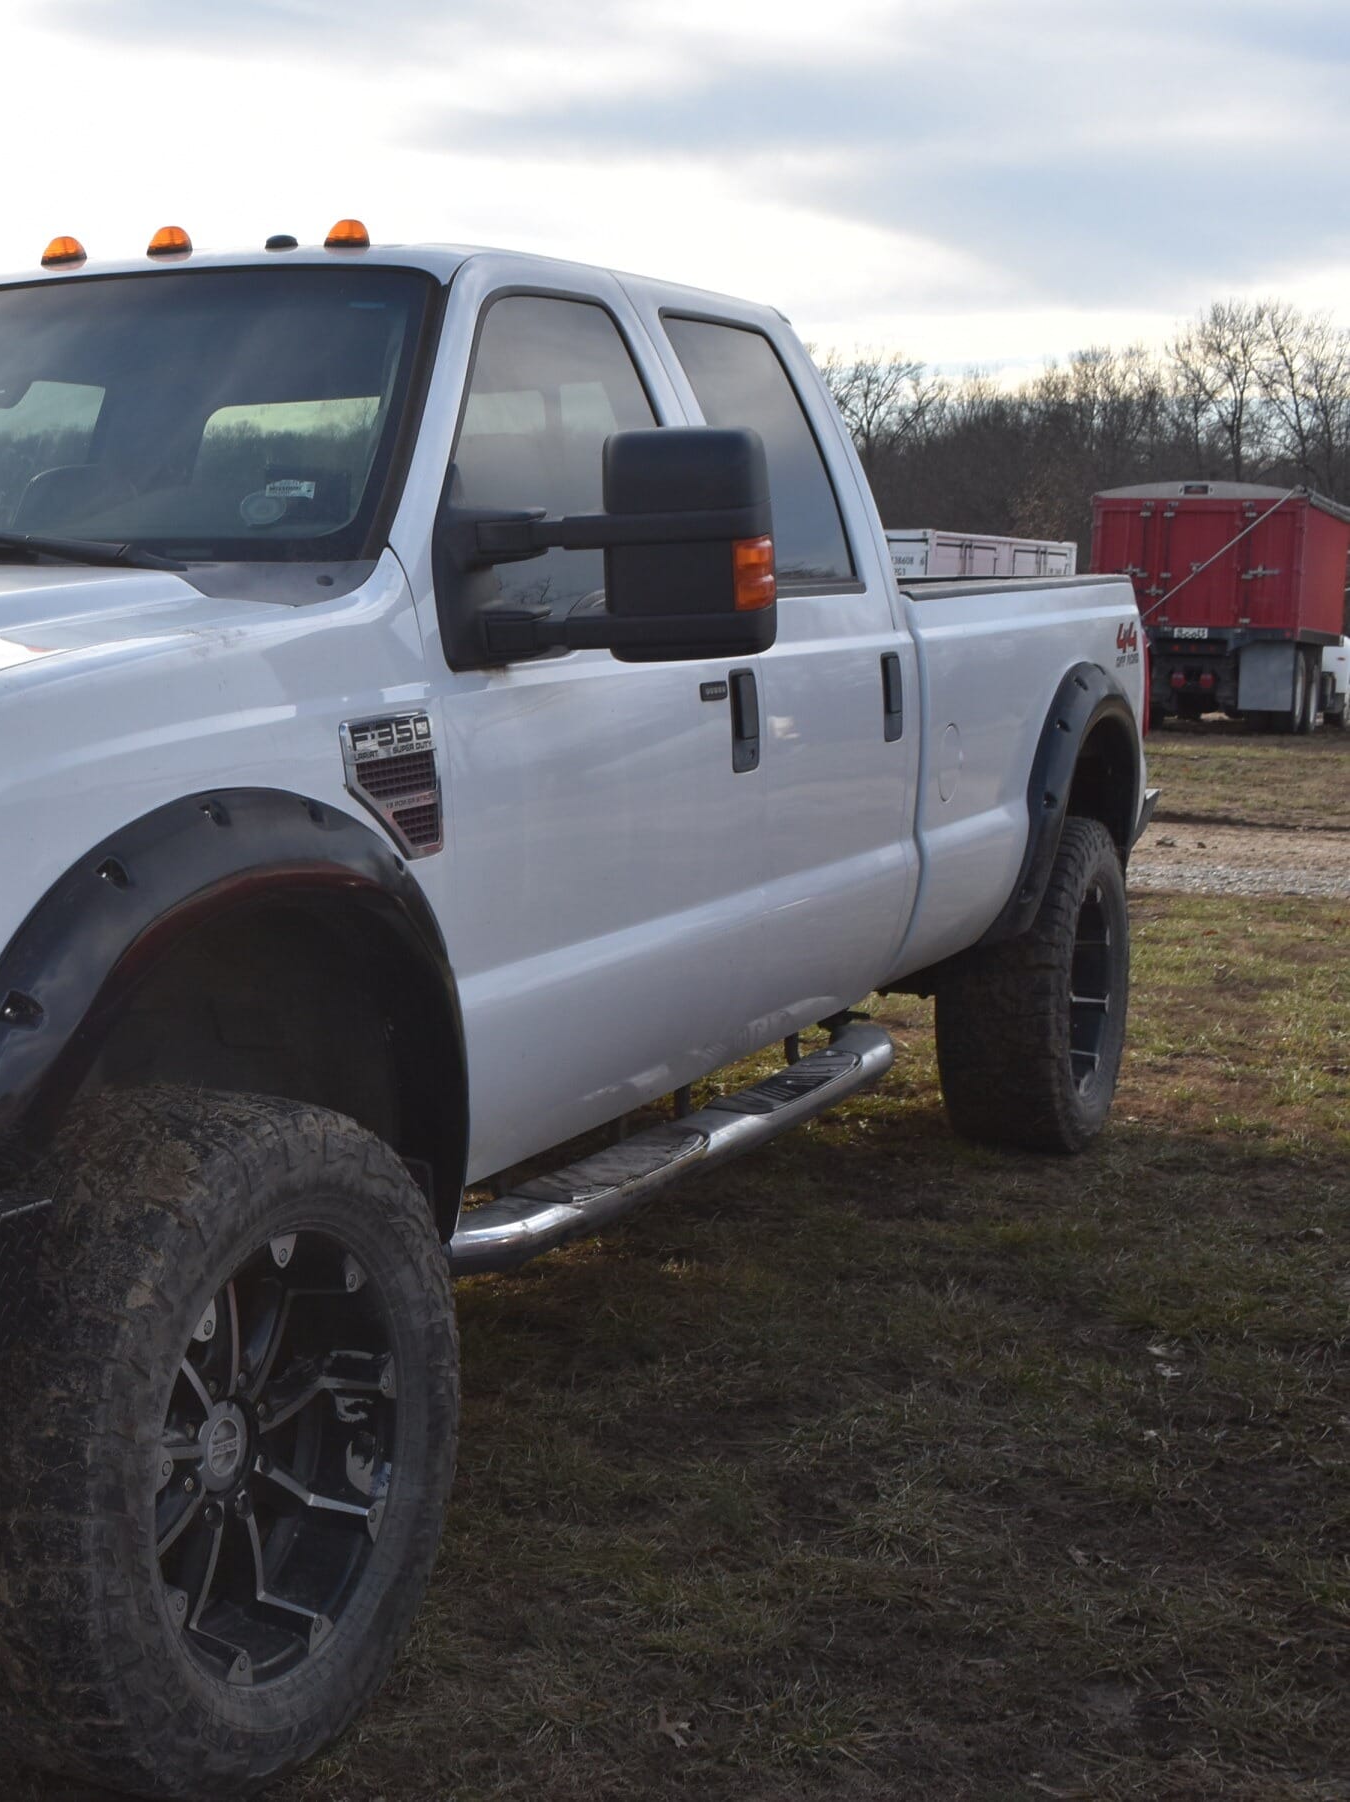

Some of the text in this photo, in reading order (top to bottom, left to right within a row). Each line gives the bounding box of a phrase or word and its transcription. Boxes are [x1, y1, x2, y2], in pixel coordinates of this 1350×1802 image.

[349, 716, 431, 751] F-350
[393, 740, 433, 754] SUPER DUTY
[354, 750, 378, 761] LARIAT
